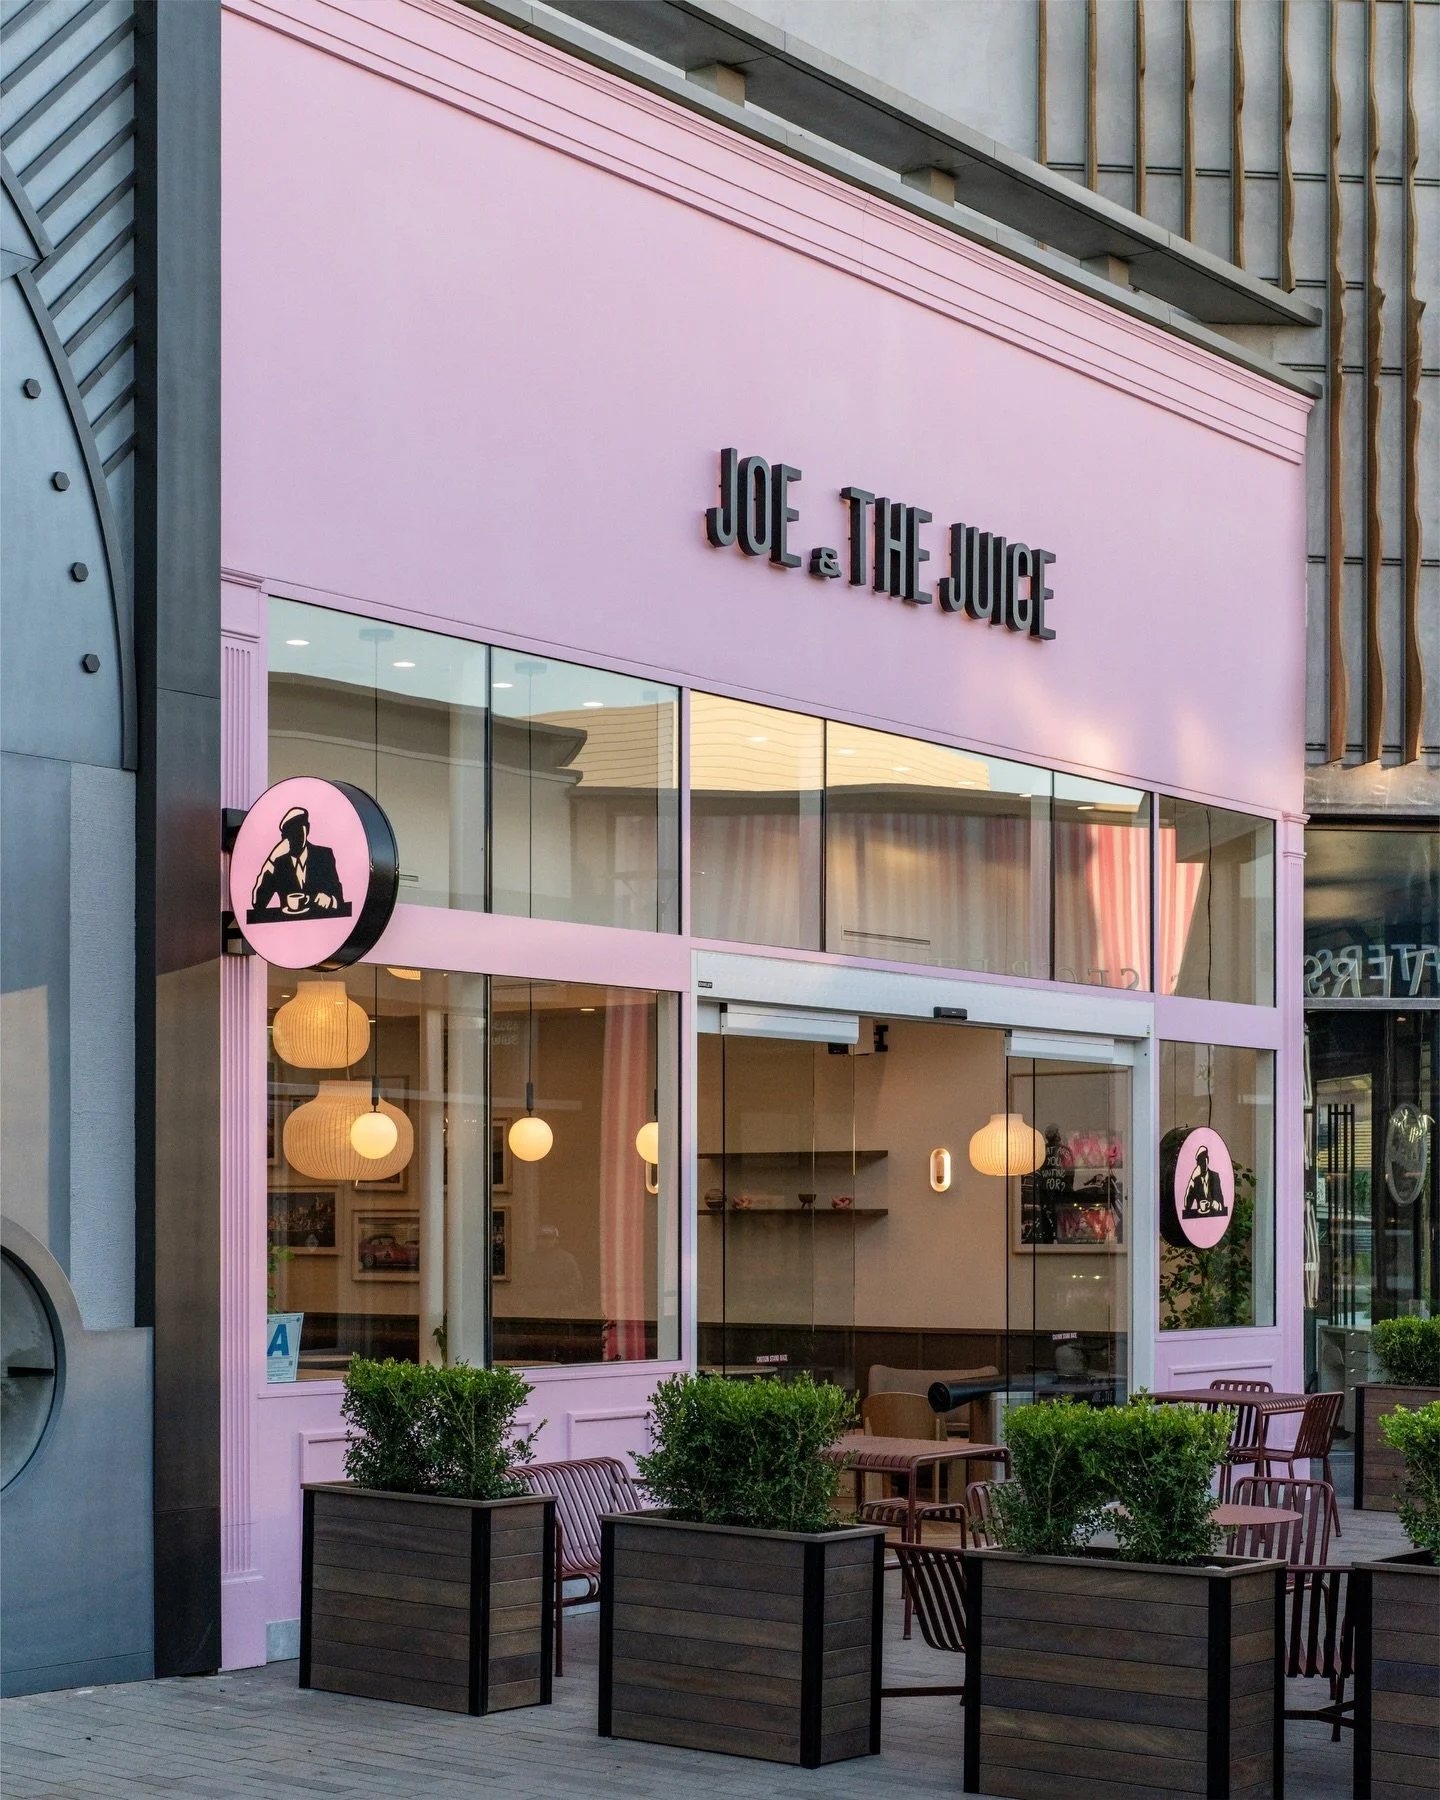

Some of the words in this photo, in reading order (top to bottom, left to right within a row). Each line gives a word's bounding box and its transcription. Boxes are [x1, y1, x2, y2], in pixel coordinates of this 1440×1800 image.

[705, 447, 802, 568] JOE
[810, 547, 842, 579] &
[840, 486, 933, 605] THE
[938, 522, 1057, 640] JUICE
[267, 1323, 290, 1357] A
